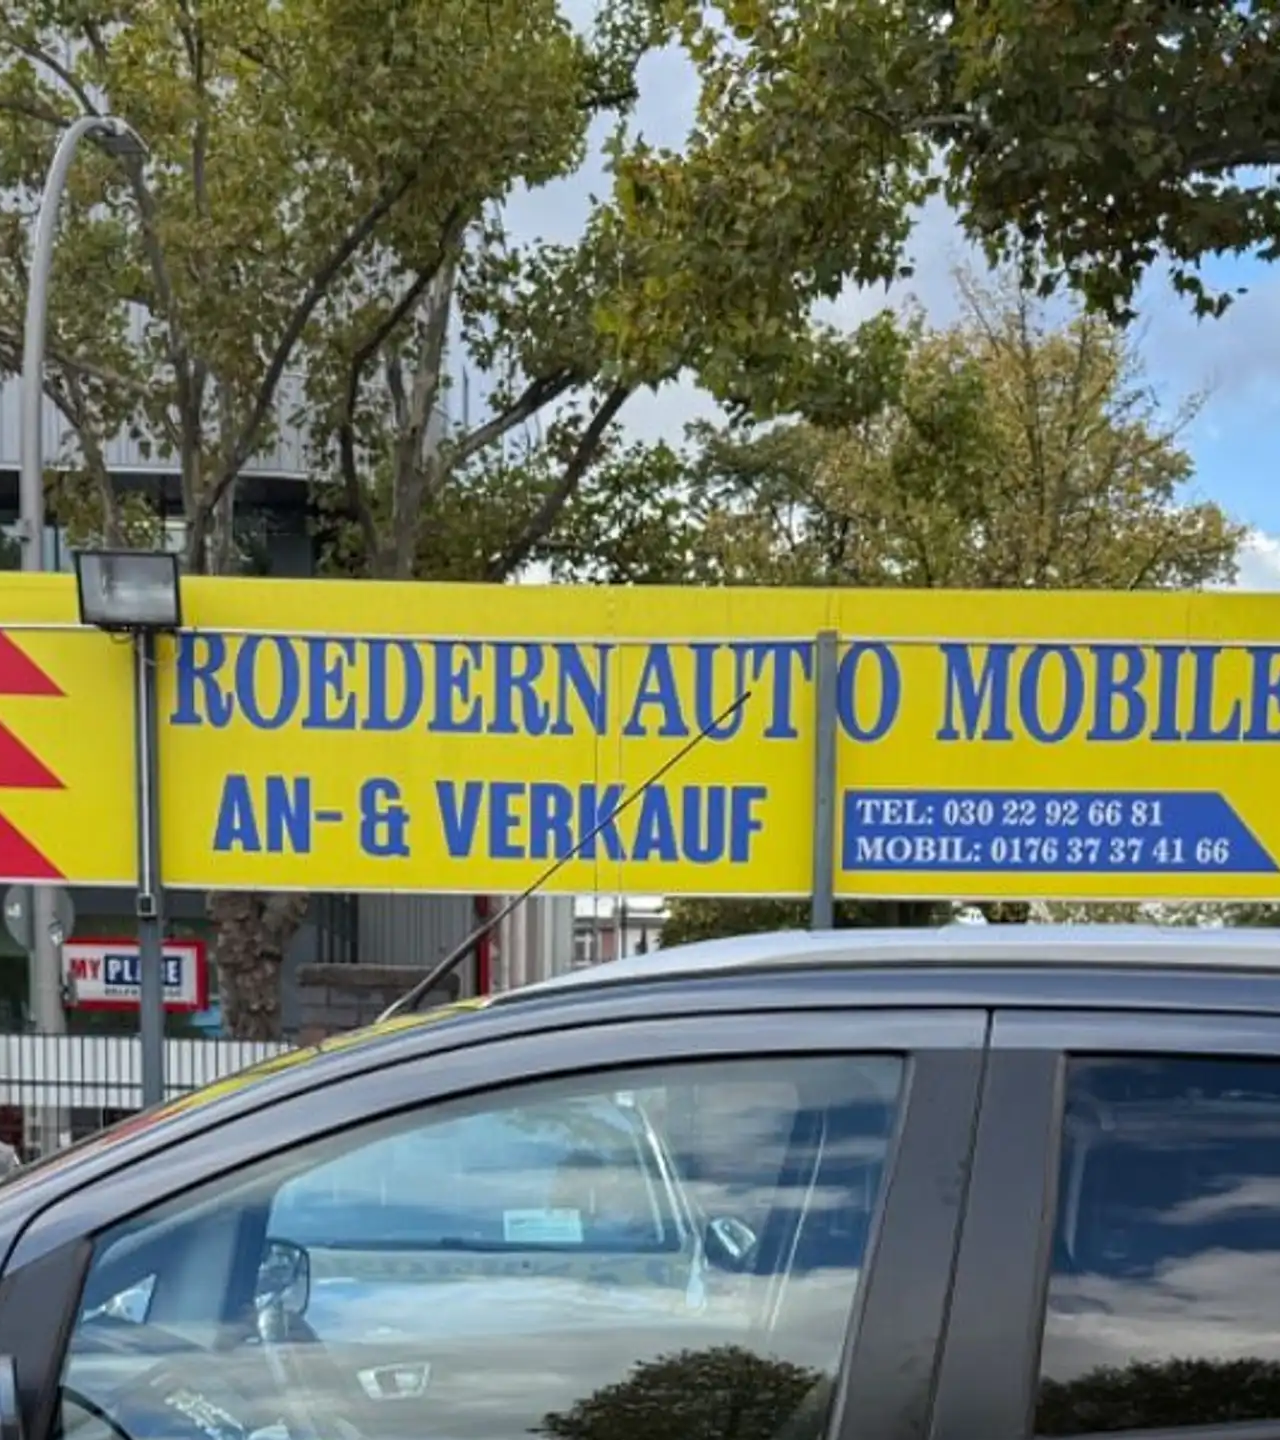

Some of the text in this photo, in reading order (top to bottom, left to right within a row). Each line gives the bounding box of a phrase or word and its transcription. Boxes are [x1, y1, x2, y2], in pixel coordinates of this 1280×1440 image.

[213, 774, 767, 863] AN- & VERKAUF
[856, 798, 1163, 828] TEL: 030 22 92 66 81
[855, 836, 1230, 865] MOBIL: 0176 37 37 41 66
